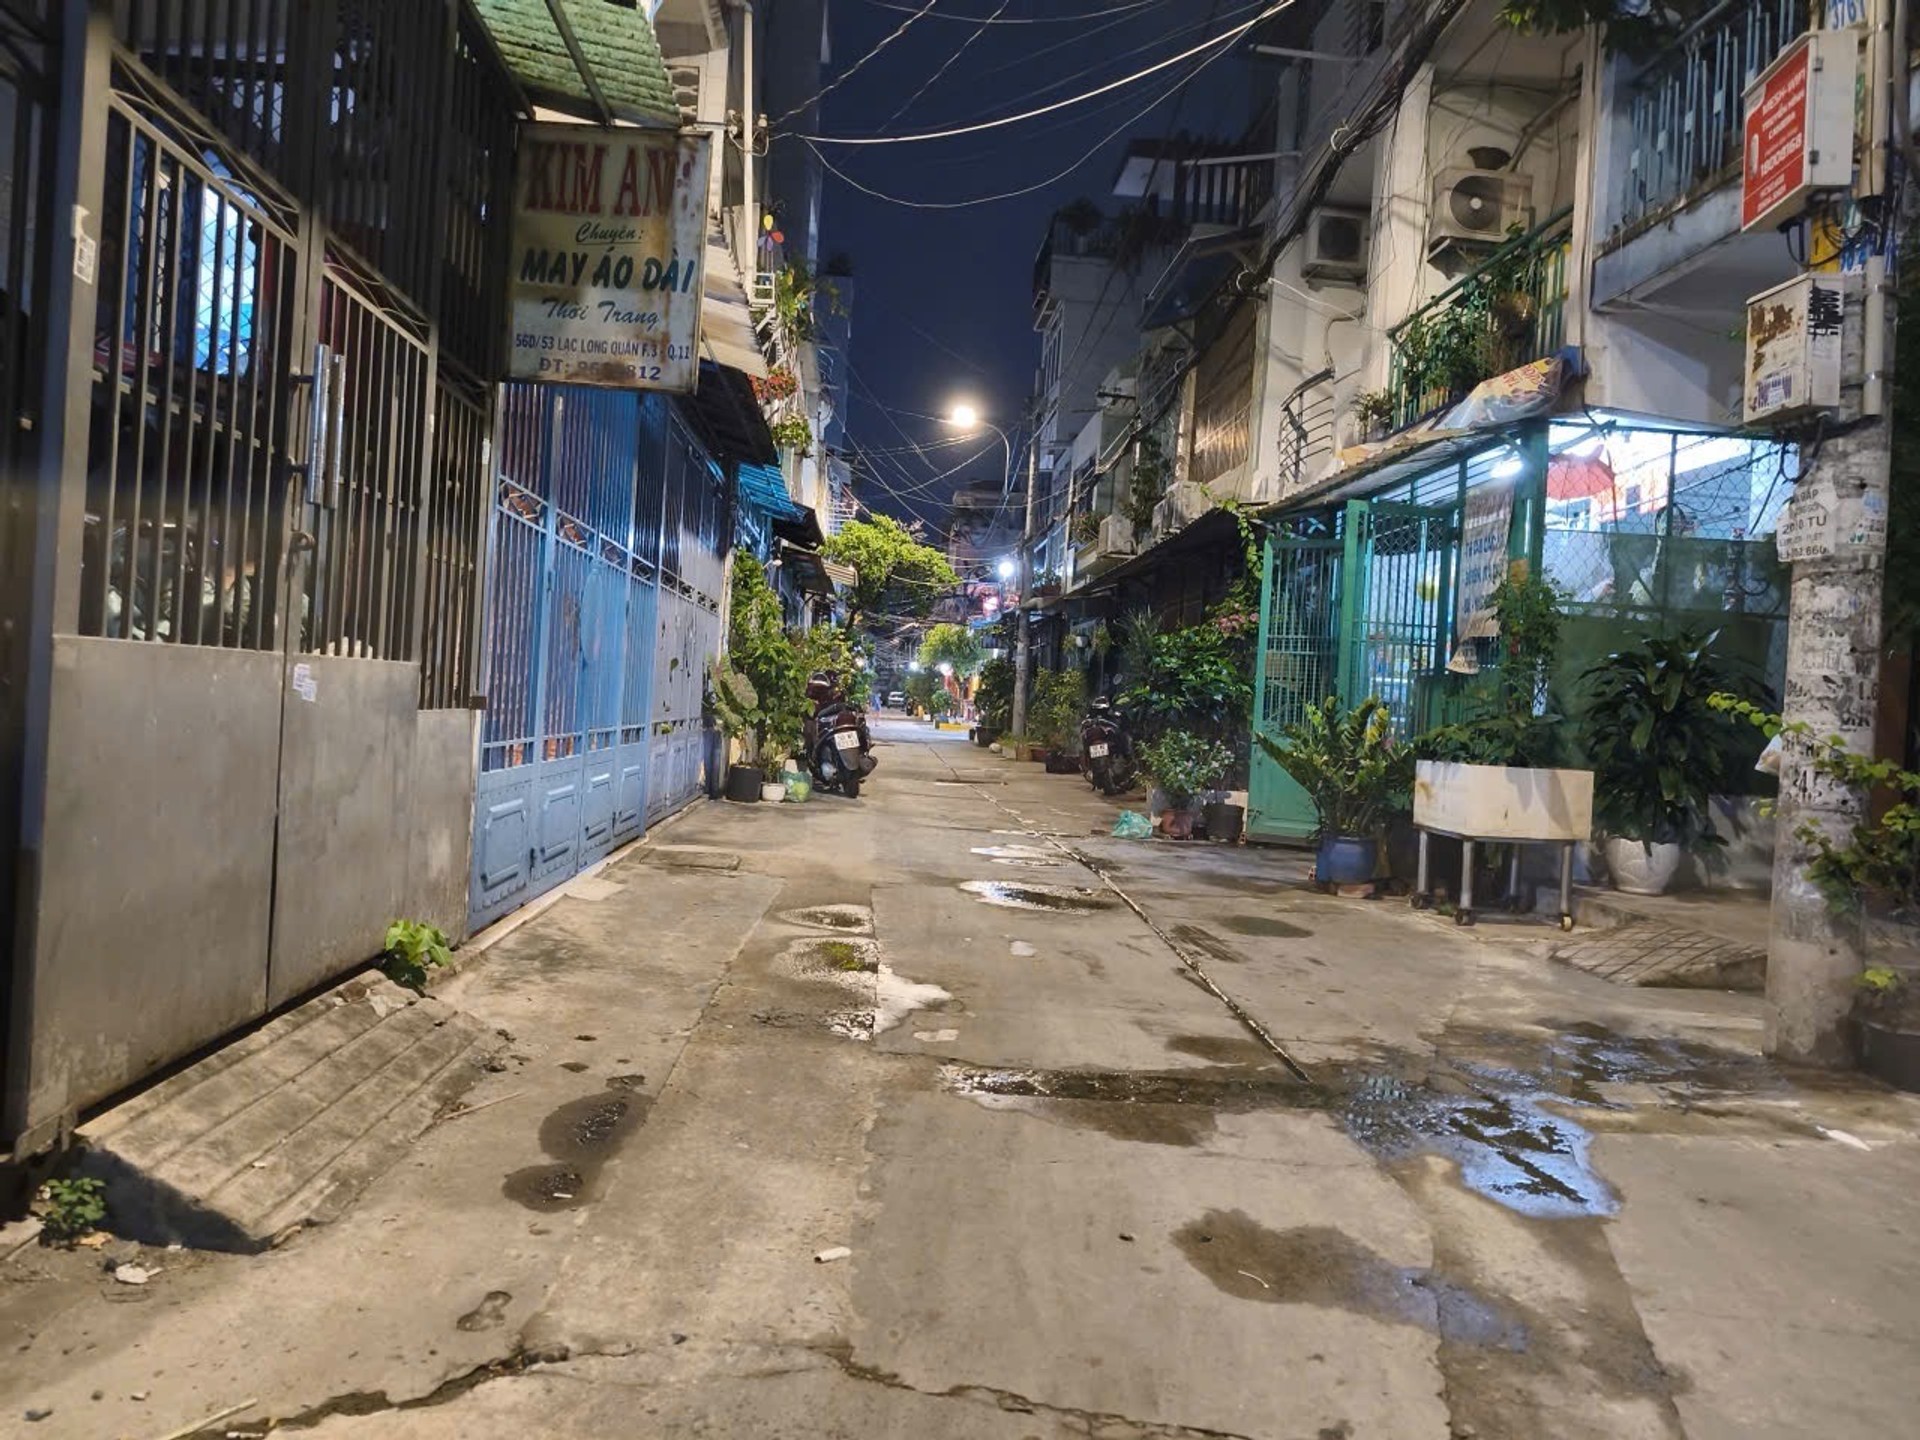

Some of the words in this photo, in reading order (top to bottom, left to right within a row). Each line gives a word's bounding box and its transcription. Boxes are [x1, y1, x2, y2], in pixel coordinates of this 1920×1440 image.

[526, 143, 608, 214] KIM
[521, 250, 588, 286] MAY
[592, 247, 633, 289] ÁO
[643, 247, 695, 293] DÀI
[598, 301, 659, 331] Trang
[581, 340, 607, 354] LONG
